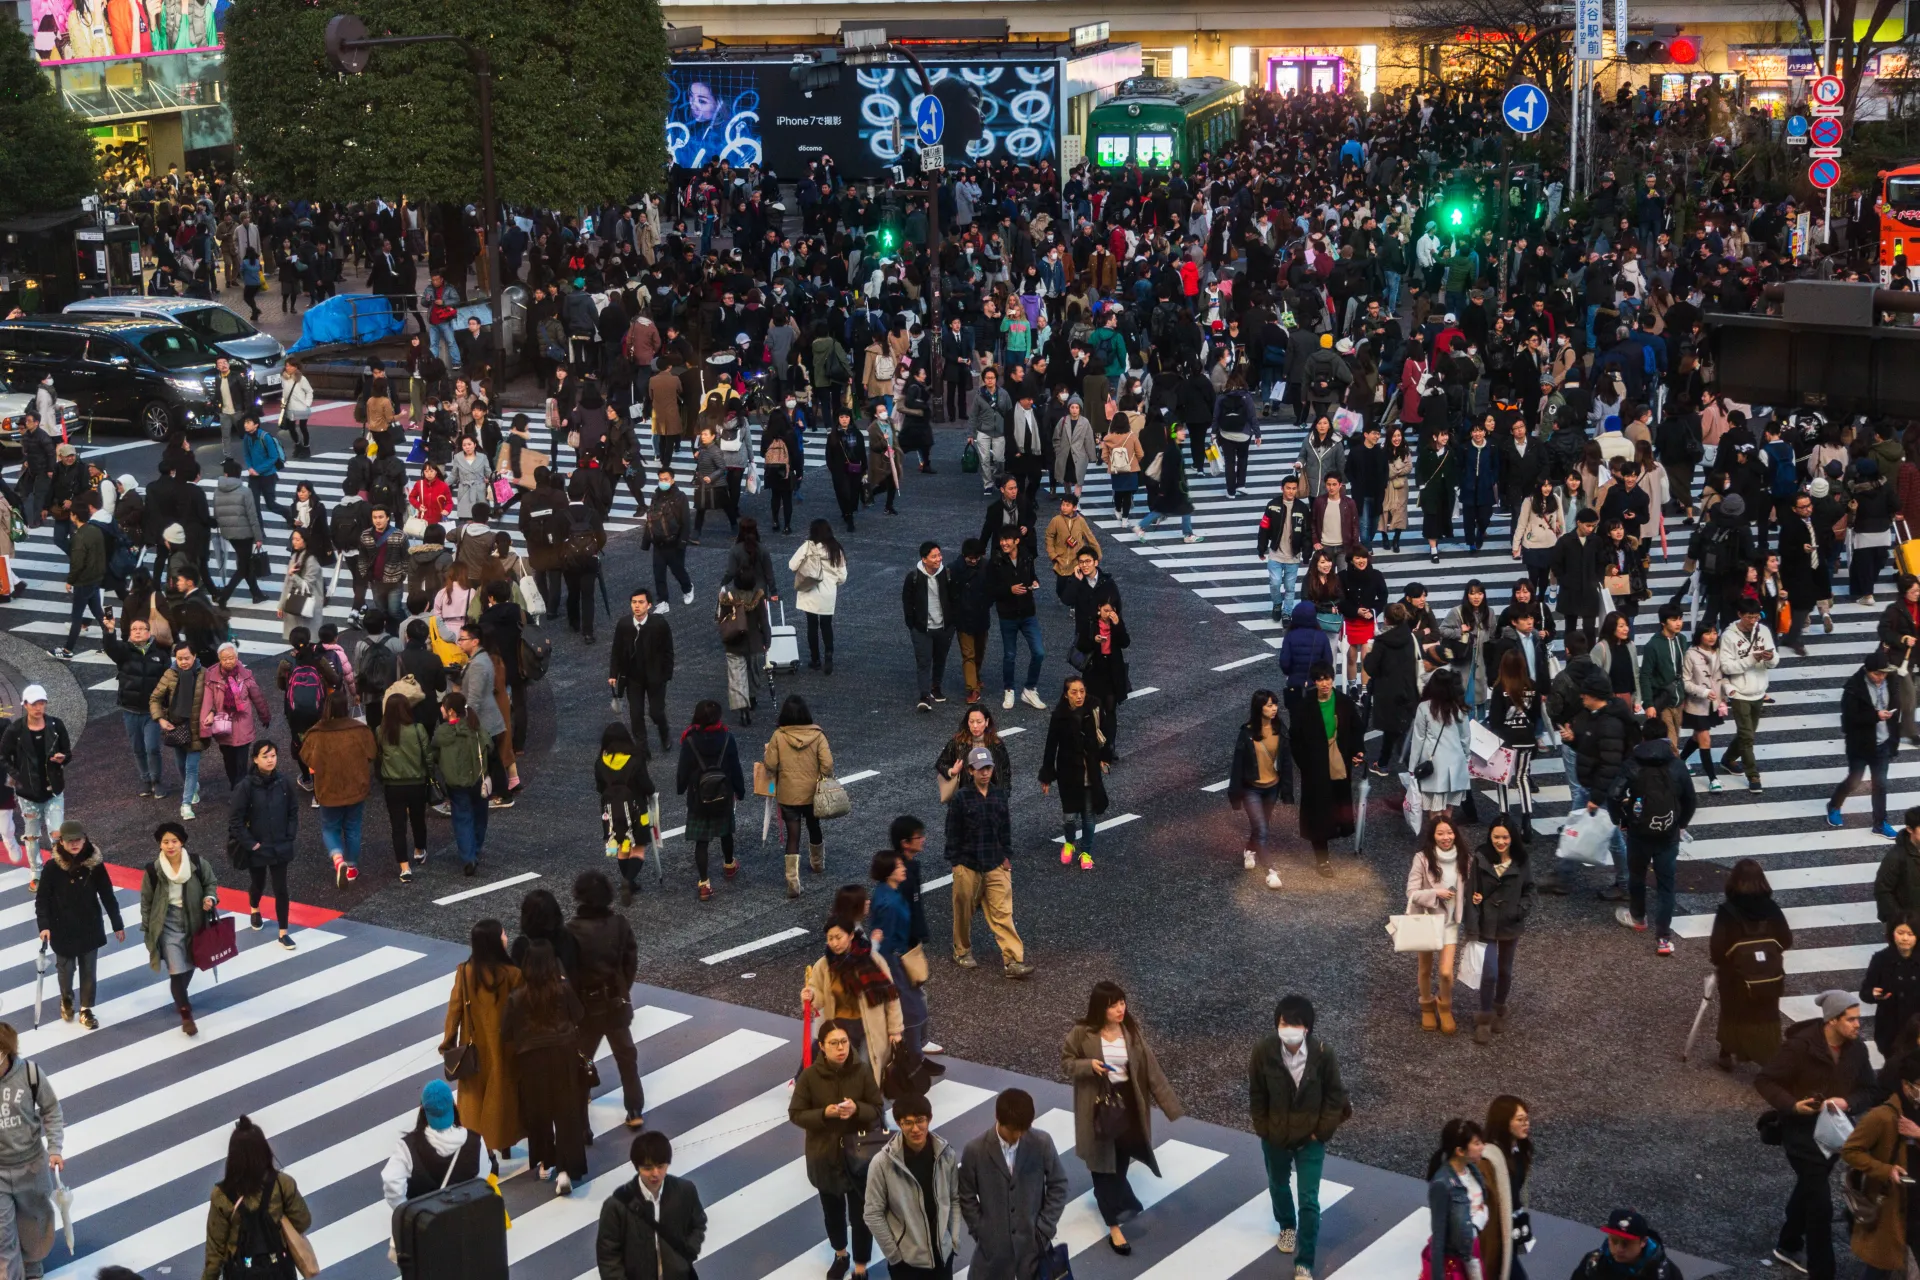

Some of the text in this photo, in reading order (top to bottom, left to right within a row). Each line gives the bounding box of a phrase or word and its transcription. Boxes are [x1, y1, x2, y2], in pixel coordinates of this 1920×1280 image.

[776, 116, 842, 126] iPhone 7で撮影
[210, 947, 232, 962] BEAMS
